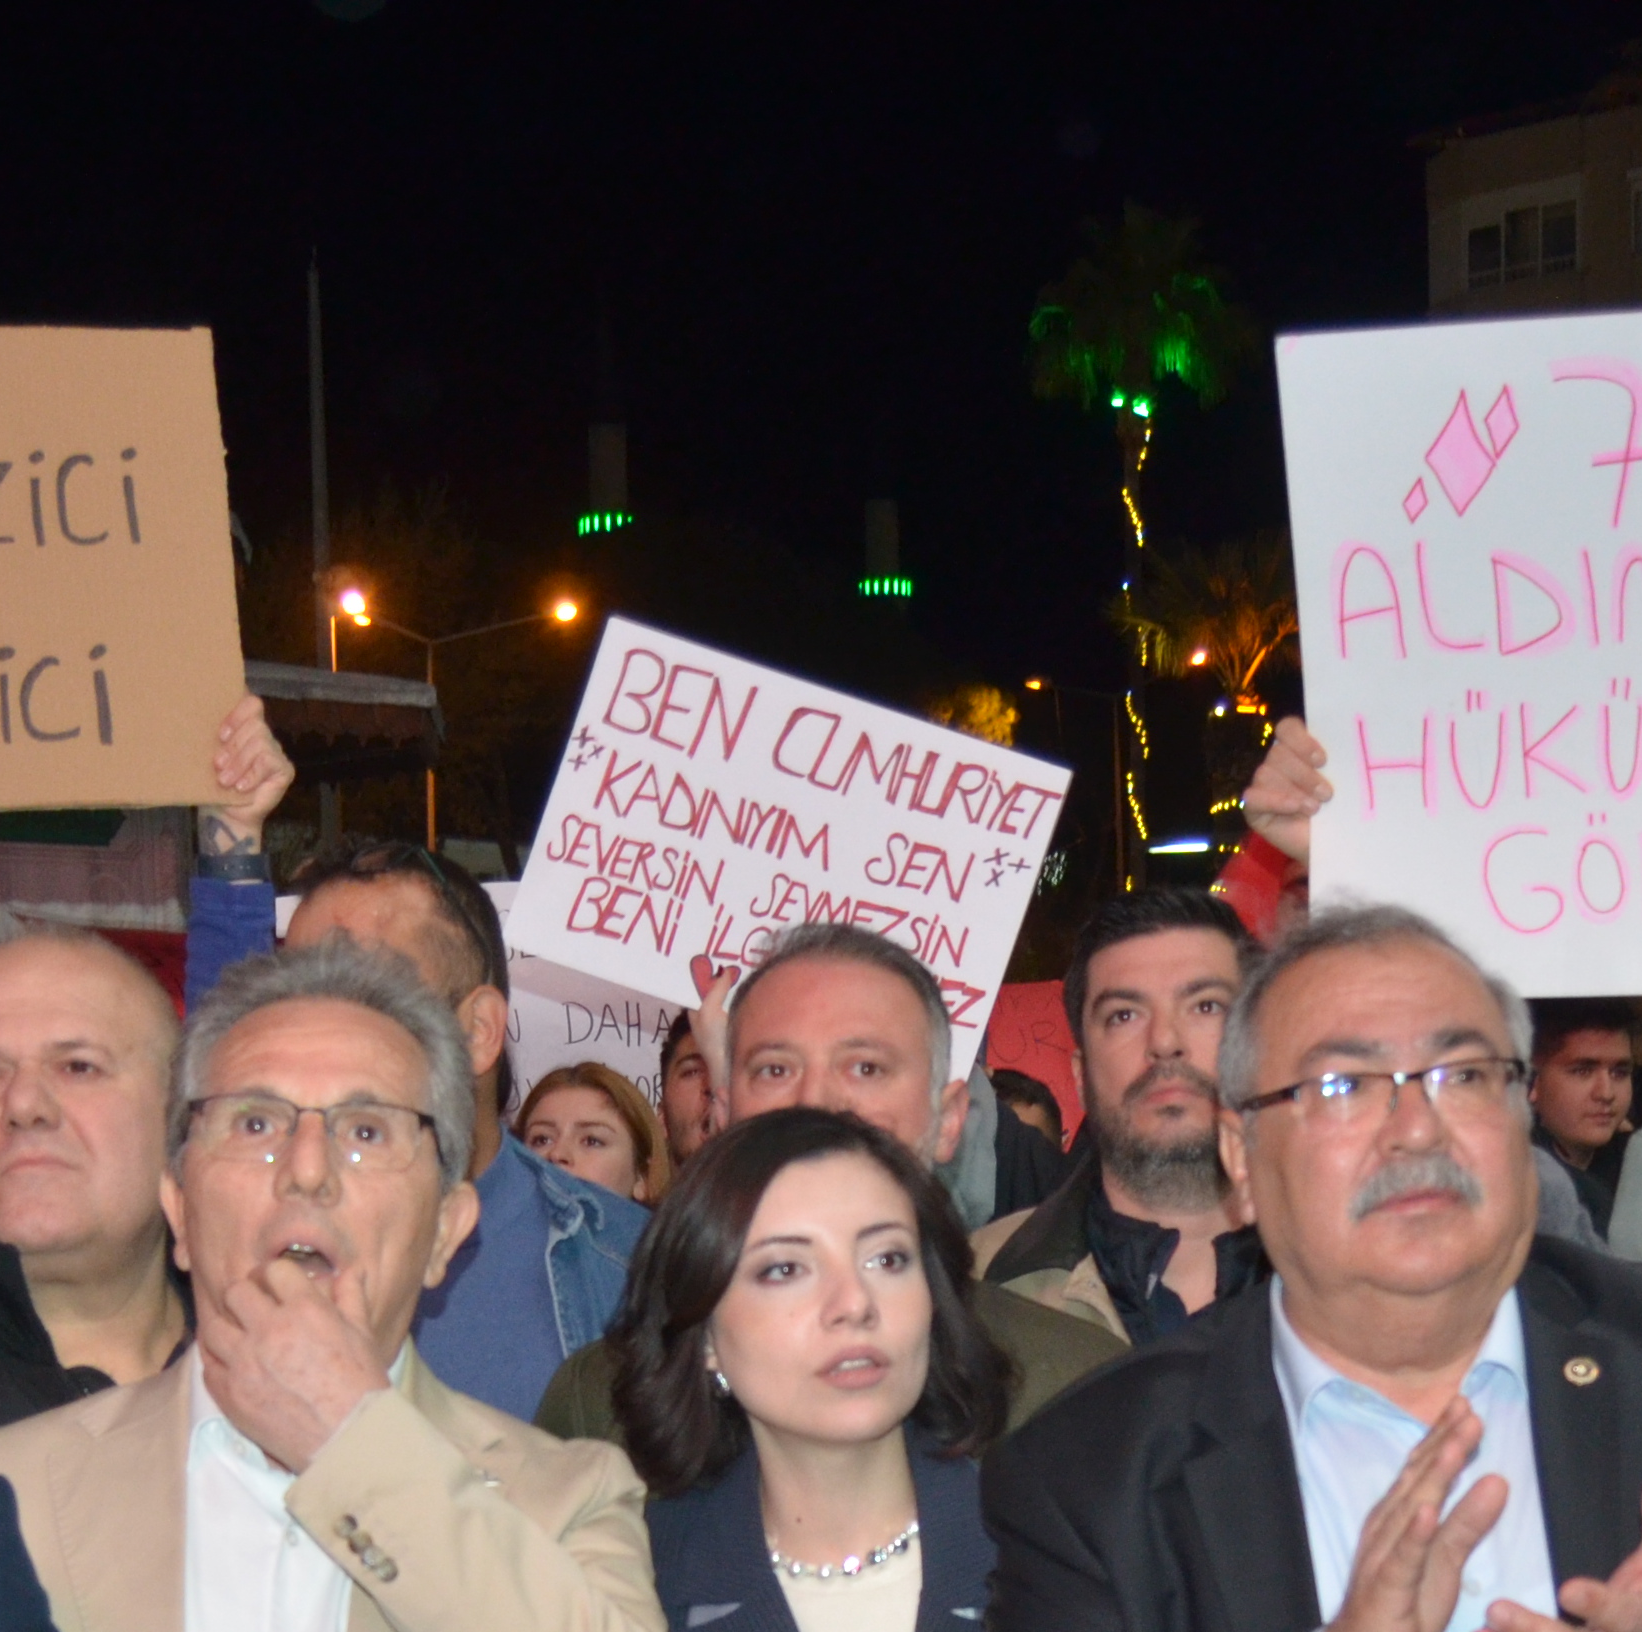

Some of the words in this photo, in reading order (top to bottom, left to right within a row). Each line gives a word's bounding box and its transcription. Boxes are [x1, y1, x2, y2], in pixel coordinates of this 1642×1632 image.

[602, 648, 758, 761] BEN
[546, 813, 725, 907] SEVERSİN
[864, 832, 975, 903] SEN
[566, 876, 684, 957] BENİ
